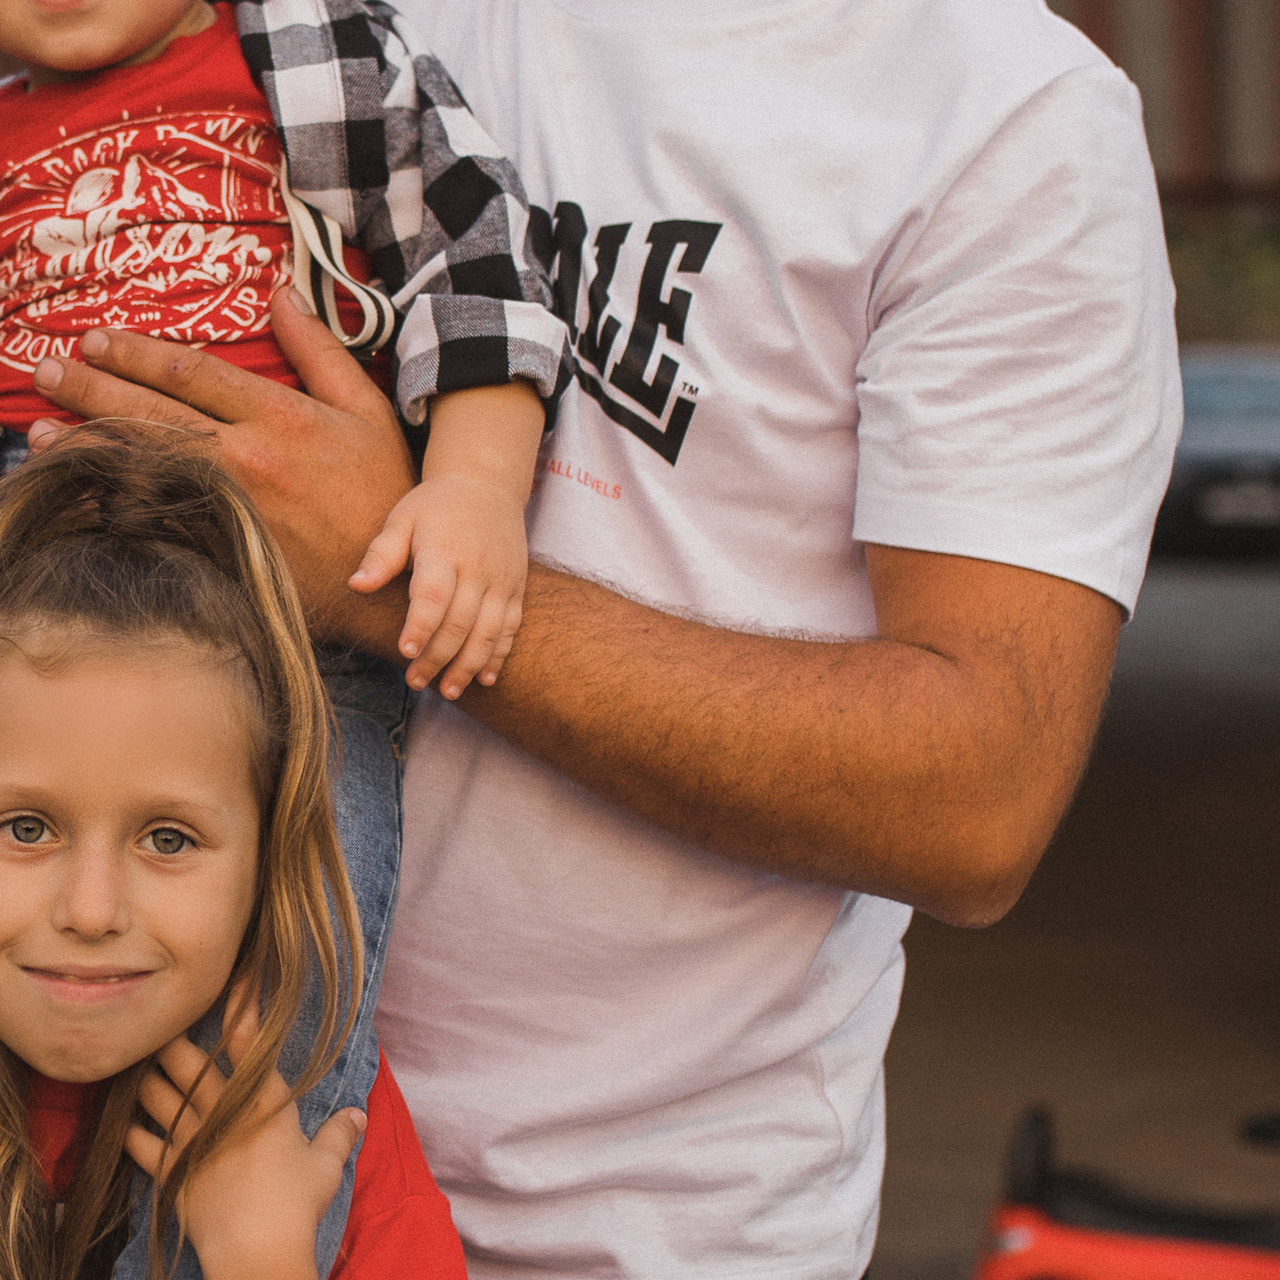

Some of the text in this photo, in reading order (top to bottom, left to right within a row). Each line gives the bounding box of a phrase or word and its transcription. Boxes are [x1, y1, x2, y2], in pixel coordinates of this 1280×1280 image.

[155, 116, 267, 156] DWN
[220, 286, 269, 328] UP
[576, 467, 622, 500] LEVELS
